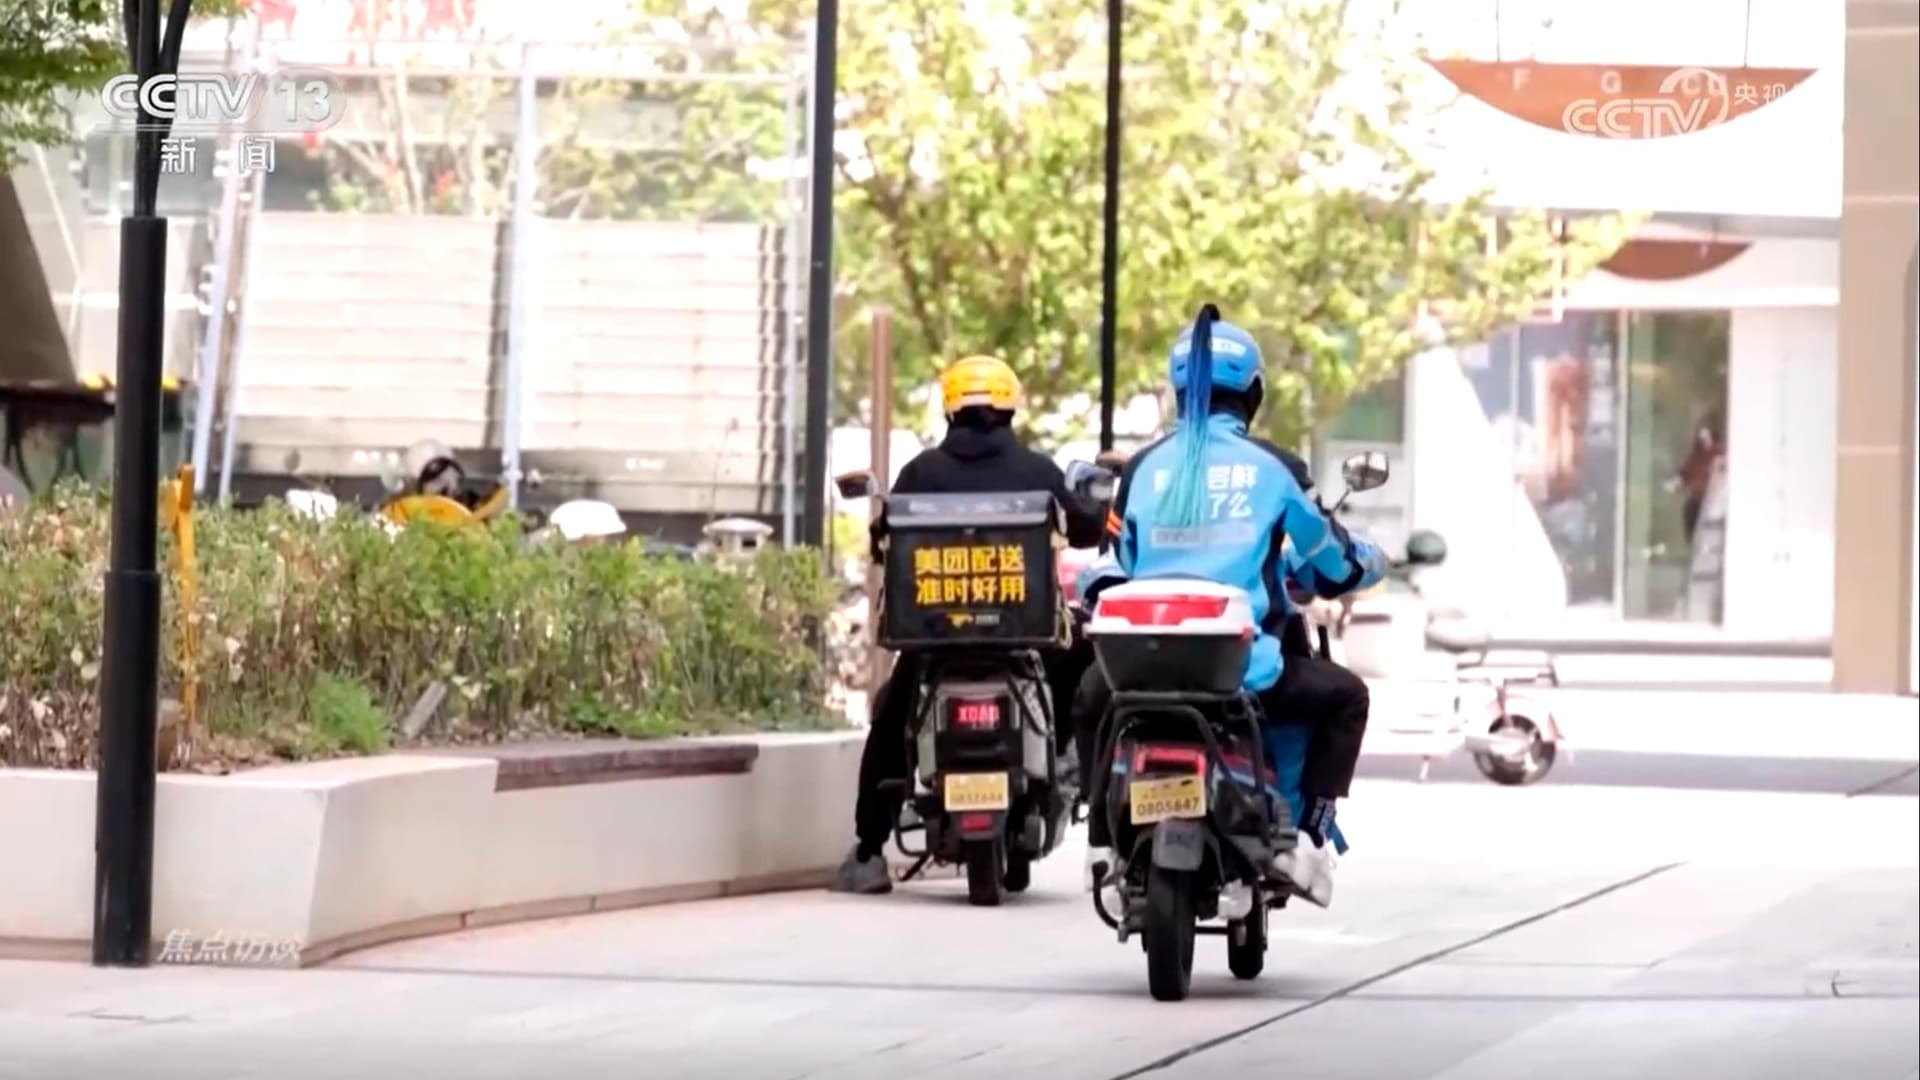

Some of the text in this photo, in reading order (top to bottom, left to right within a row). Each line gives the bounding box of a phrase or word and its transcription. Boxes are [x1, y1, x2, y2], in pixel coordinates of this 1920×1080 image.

[914, 543, 1025, 576] 美团配送
[915, 574, 1026, 605] 准时好用
